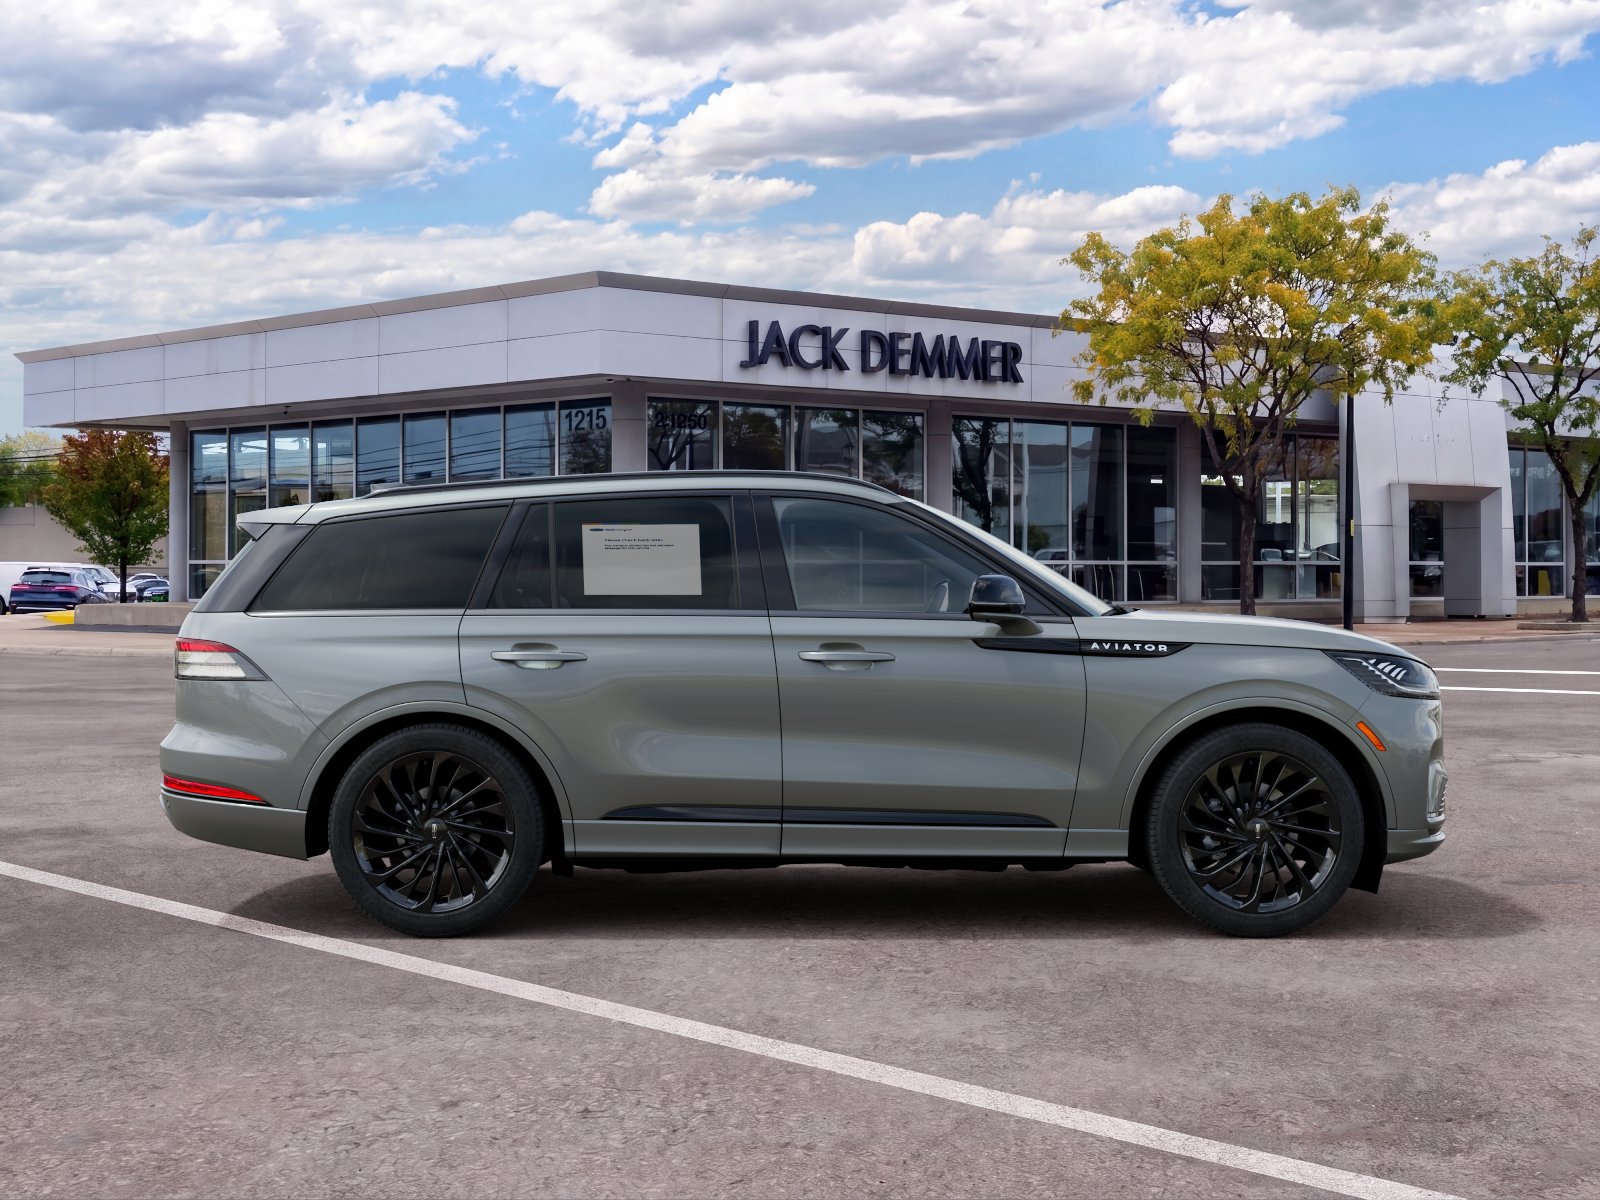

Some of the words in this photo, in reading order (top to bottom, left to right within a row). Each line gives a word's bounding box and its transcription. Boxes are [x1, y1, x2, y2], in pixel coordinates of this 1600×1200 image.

[739, 320, 850, 371] JACK
[861, 329, 1024, 383] DEMMER
[565, 408, 606, 431] 1215
[1090, 642, 1168, 652] AVIATOR
